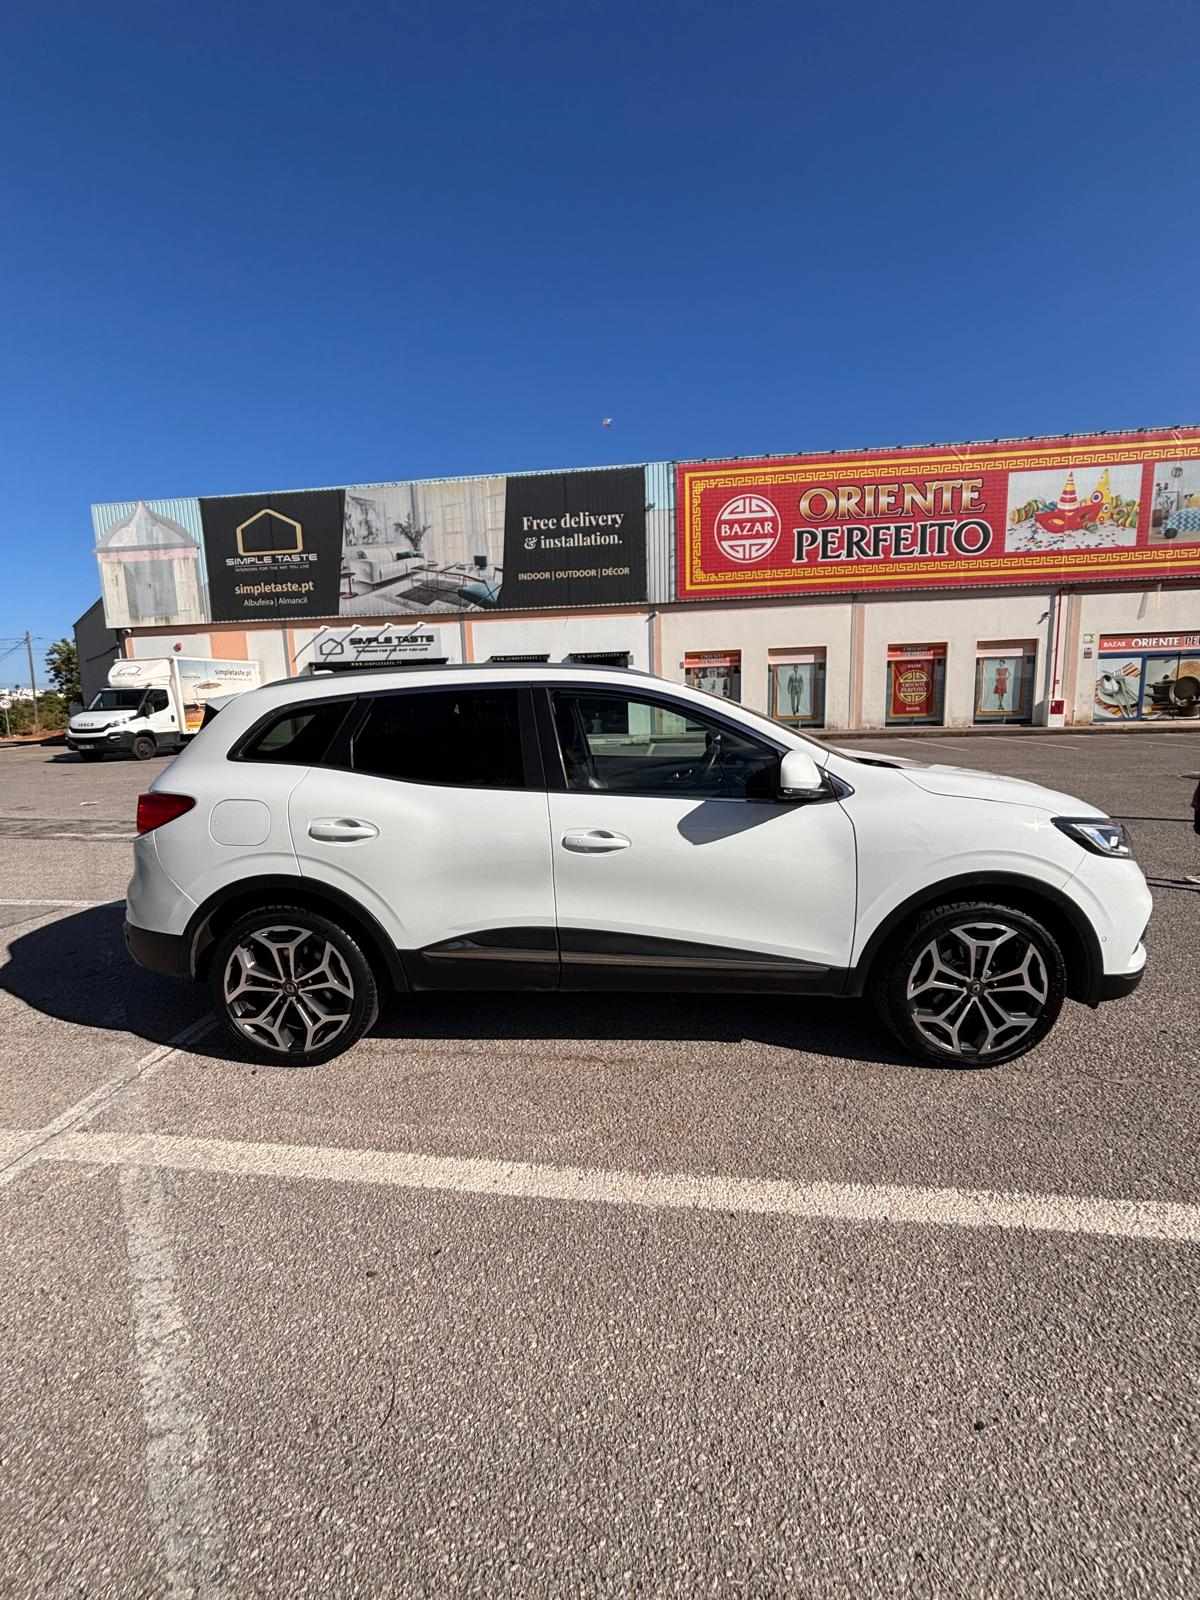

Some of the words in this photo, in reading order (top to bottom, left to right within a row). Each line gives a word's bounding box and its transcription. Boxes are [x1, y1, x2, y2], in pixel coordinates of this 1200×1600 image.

[799, 478, 986, 522] ORIENTE
[522, 516, 557, 530] Free
[560, 511, 624, 528] delivery
[720, 521, 774, 536] BAZAR
[523, 536, 538, 550] &
[540, 532, 623, 549] installation.
[792, 518, 992, 563] PERFEITO
[225, 556, 273, 566] SIMPLE
[275, 553, 318, 562] TASTE
[518, 571, 551, 581] INDOOR
[555, 569, 597, 579] OUTDOOR
[234, 581, 315, 596] simpletaste.pt
[395, 635, 434, 643] TASTE
[1131, 638, 1180, 648] ORIENTE
